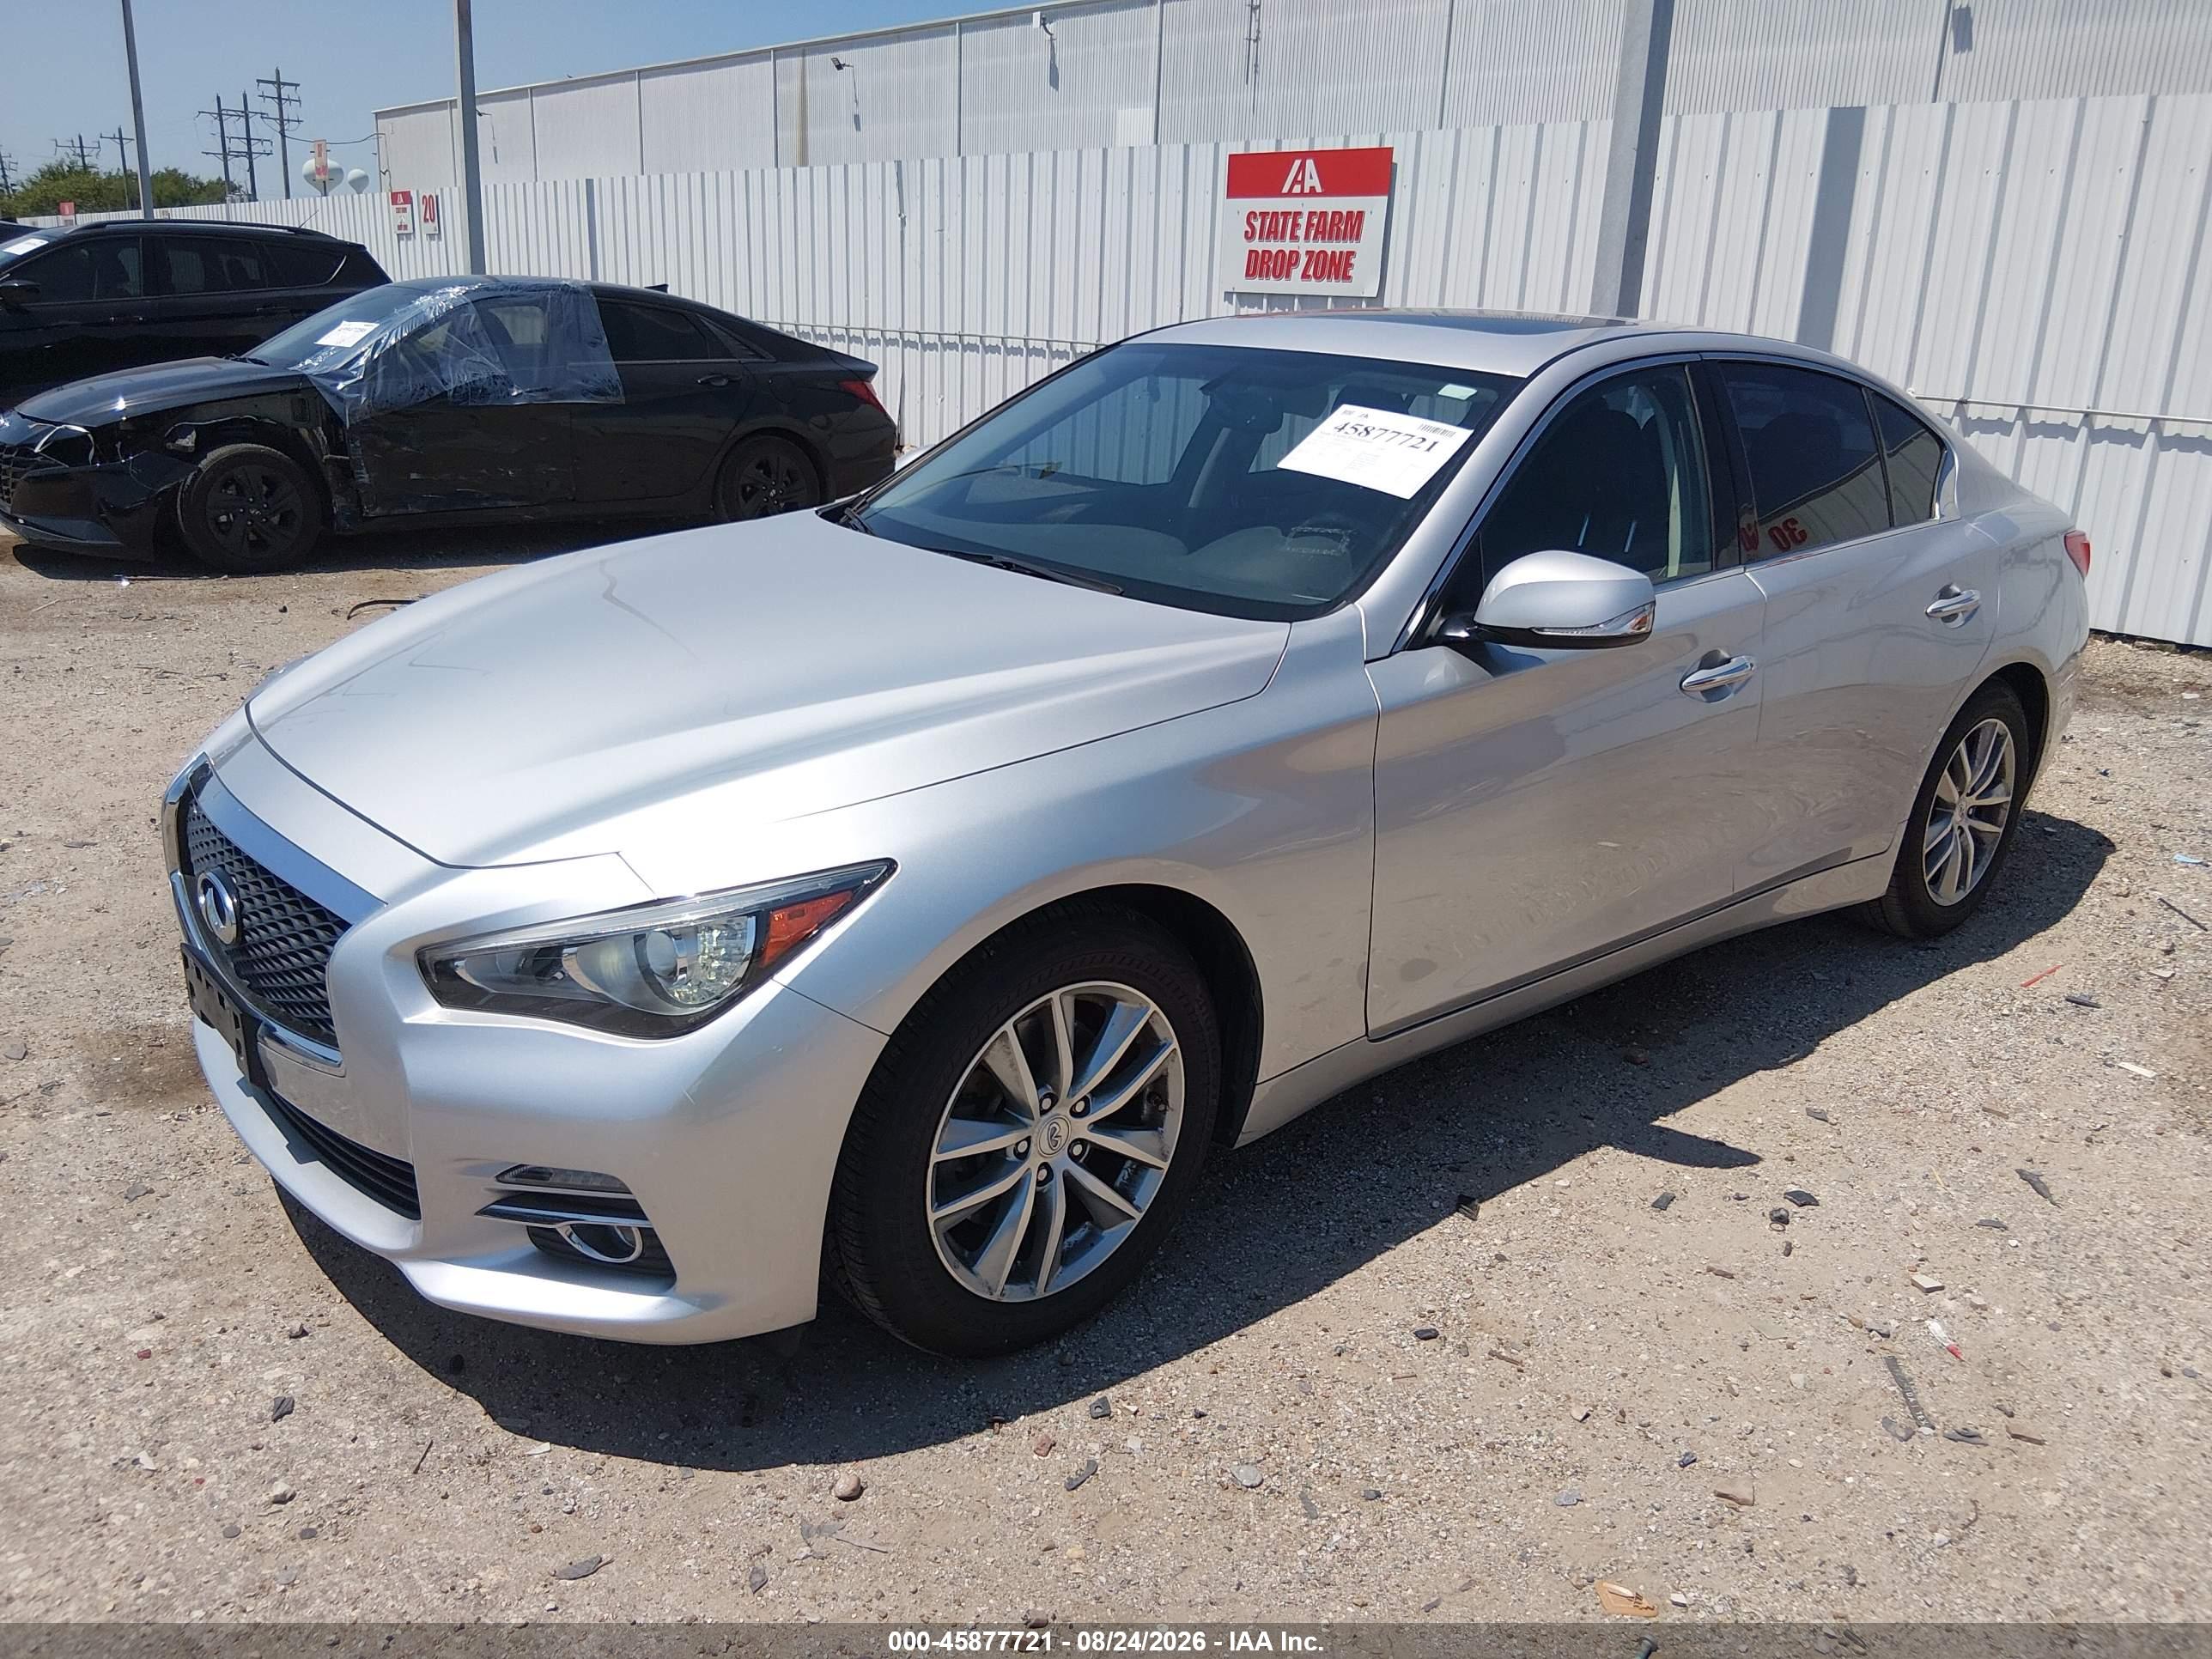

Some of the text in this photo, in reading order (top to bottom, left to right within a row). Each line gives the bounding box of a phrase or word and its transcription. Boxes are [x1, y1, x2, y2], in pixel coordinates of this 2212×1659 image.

[422, 194, 436, 223] 20
[1243, 210, 1365, 244] STATE FARM
[1244, 249, 1357, 283] DROP ZONE
[1334, 422, 1439, 453] 45877721
